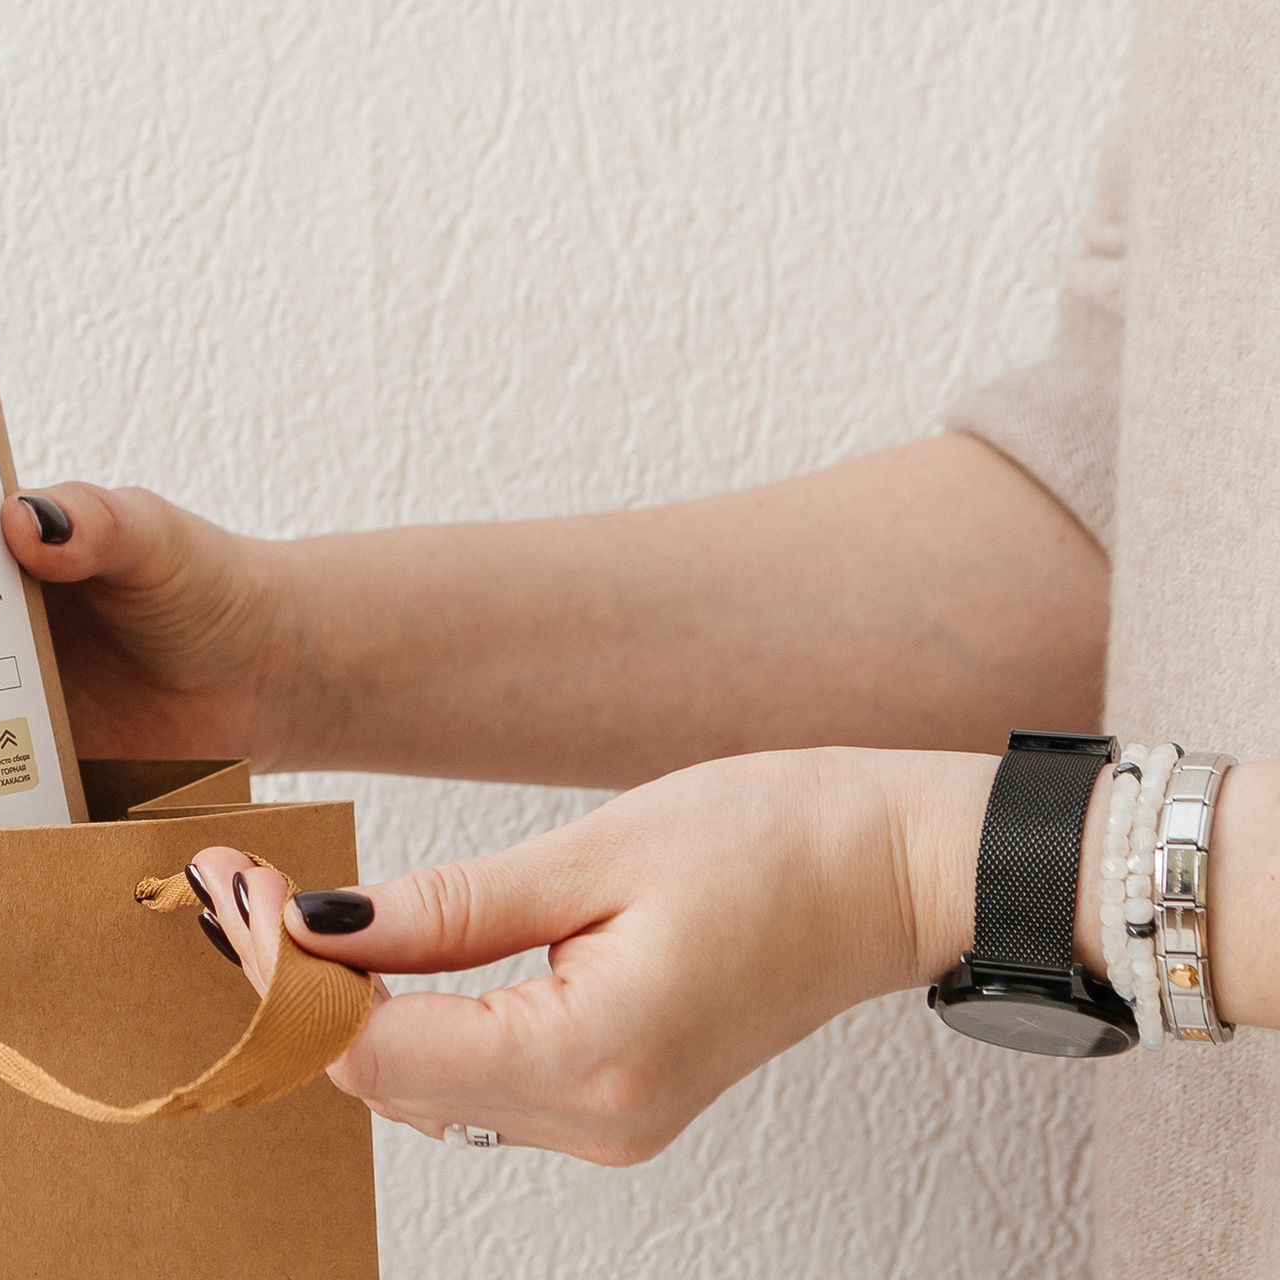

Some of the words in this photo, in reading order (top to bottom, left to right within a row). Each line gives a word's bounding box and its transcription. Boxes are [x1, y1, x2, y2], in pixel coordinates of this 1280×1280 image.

[13, 754, 30, 764] сбора
[1, 764, 26, 776] ГОРНАЯ
[0, 774, 31, 787] ХАКАСИЯ
